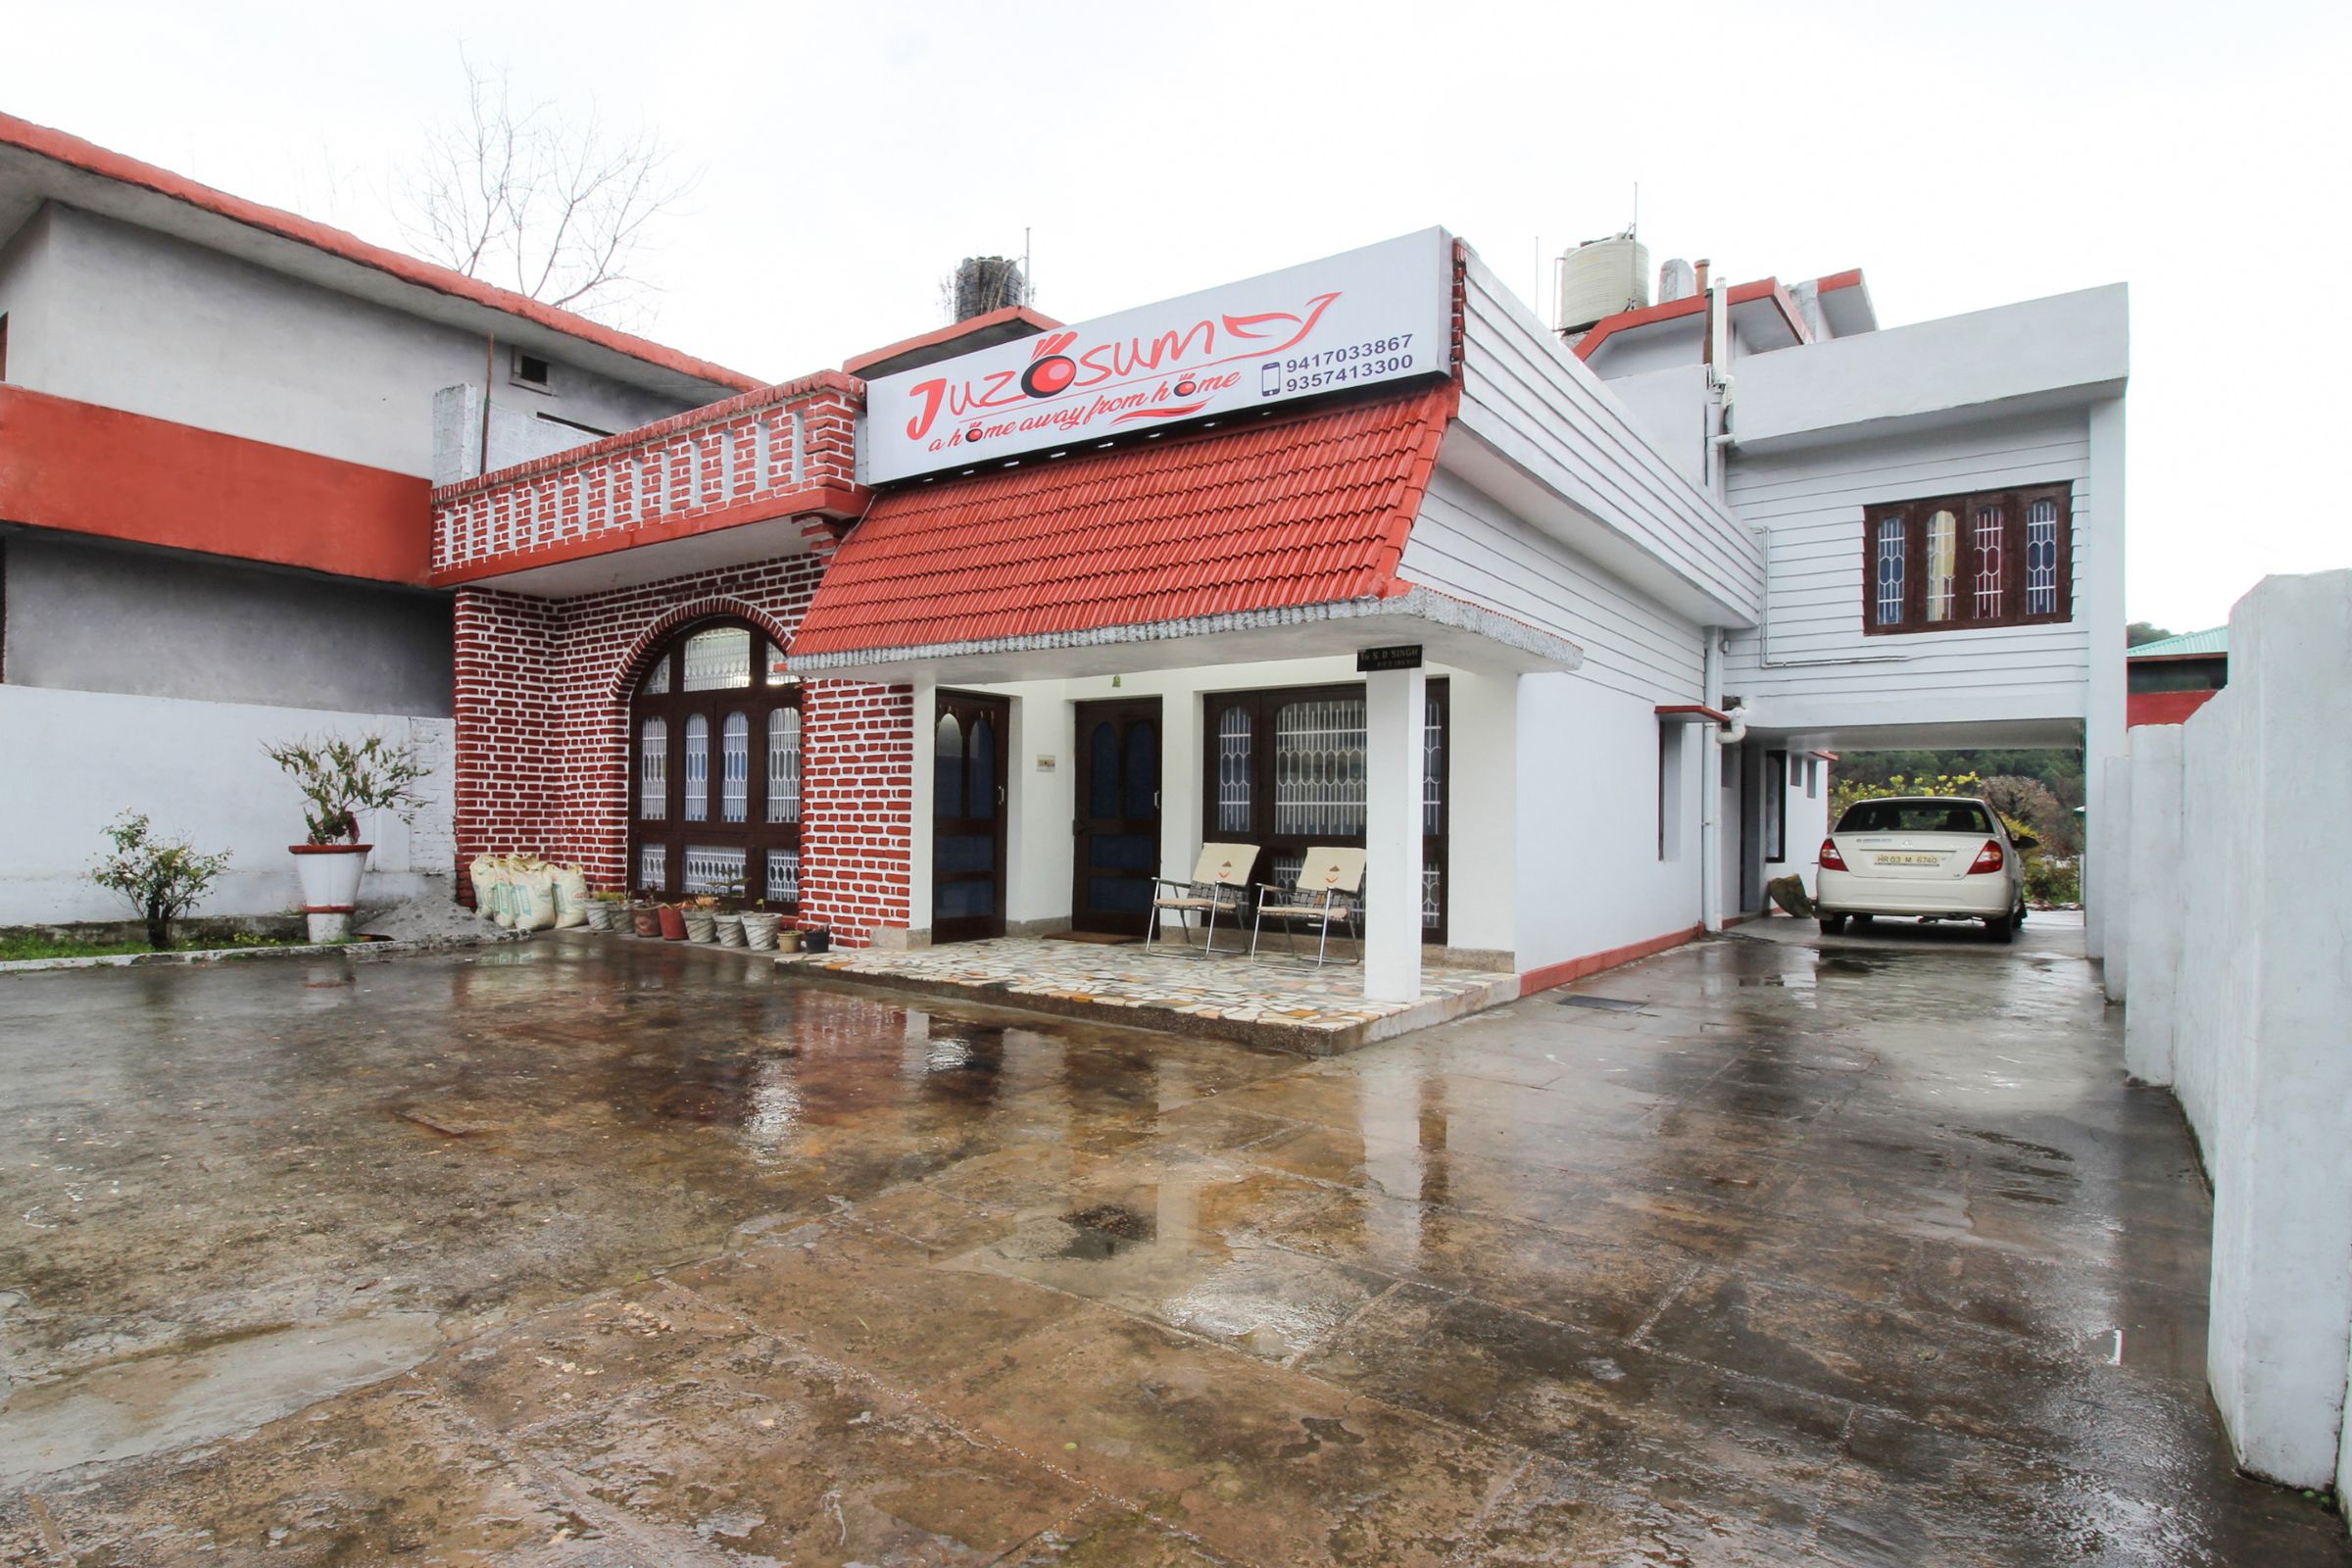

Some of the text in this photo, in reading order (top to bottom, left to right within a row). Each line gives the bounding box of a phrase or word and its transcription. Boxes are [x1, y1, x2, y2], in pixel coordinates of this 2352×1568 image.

[1286, 333, 1413, 373] 9417033867
[1286, 354, 1413, 392] 9357413300
[928, 436, 943, 453] a
[1018, 403, 1081, 431] away
[1082, 391, 1148, 425] from
